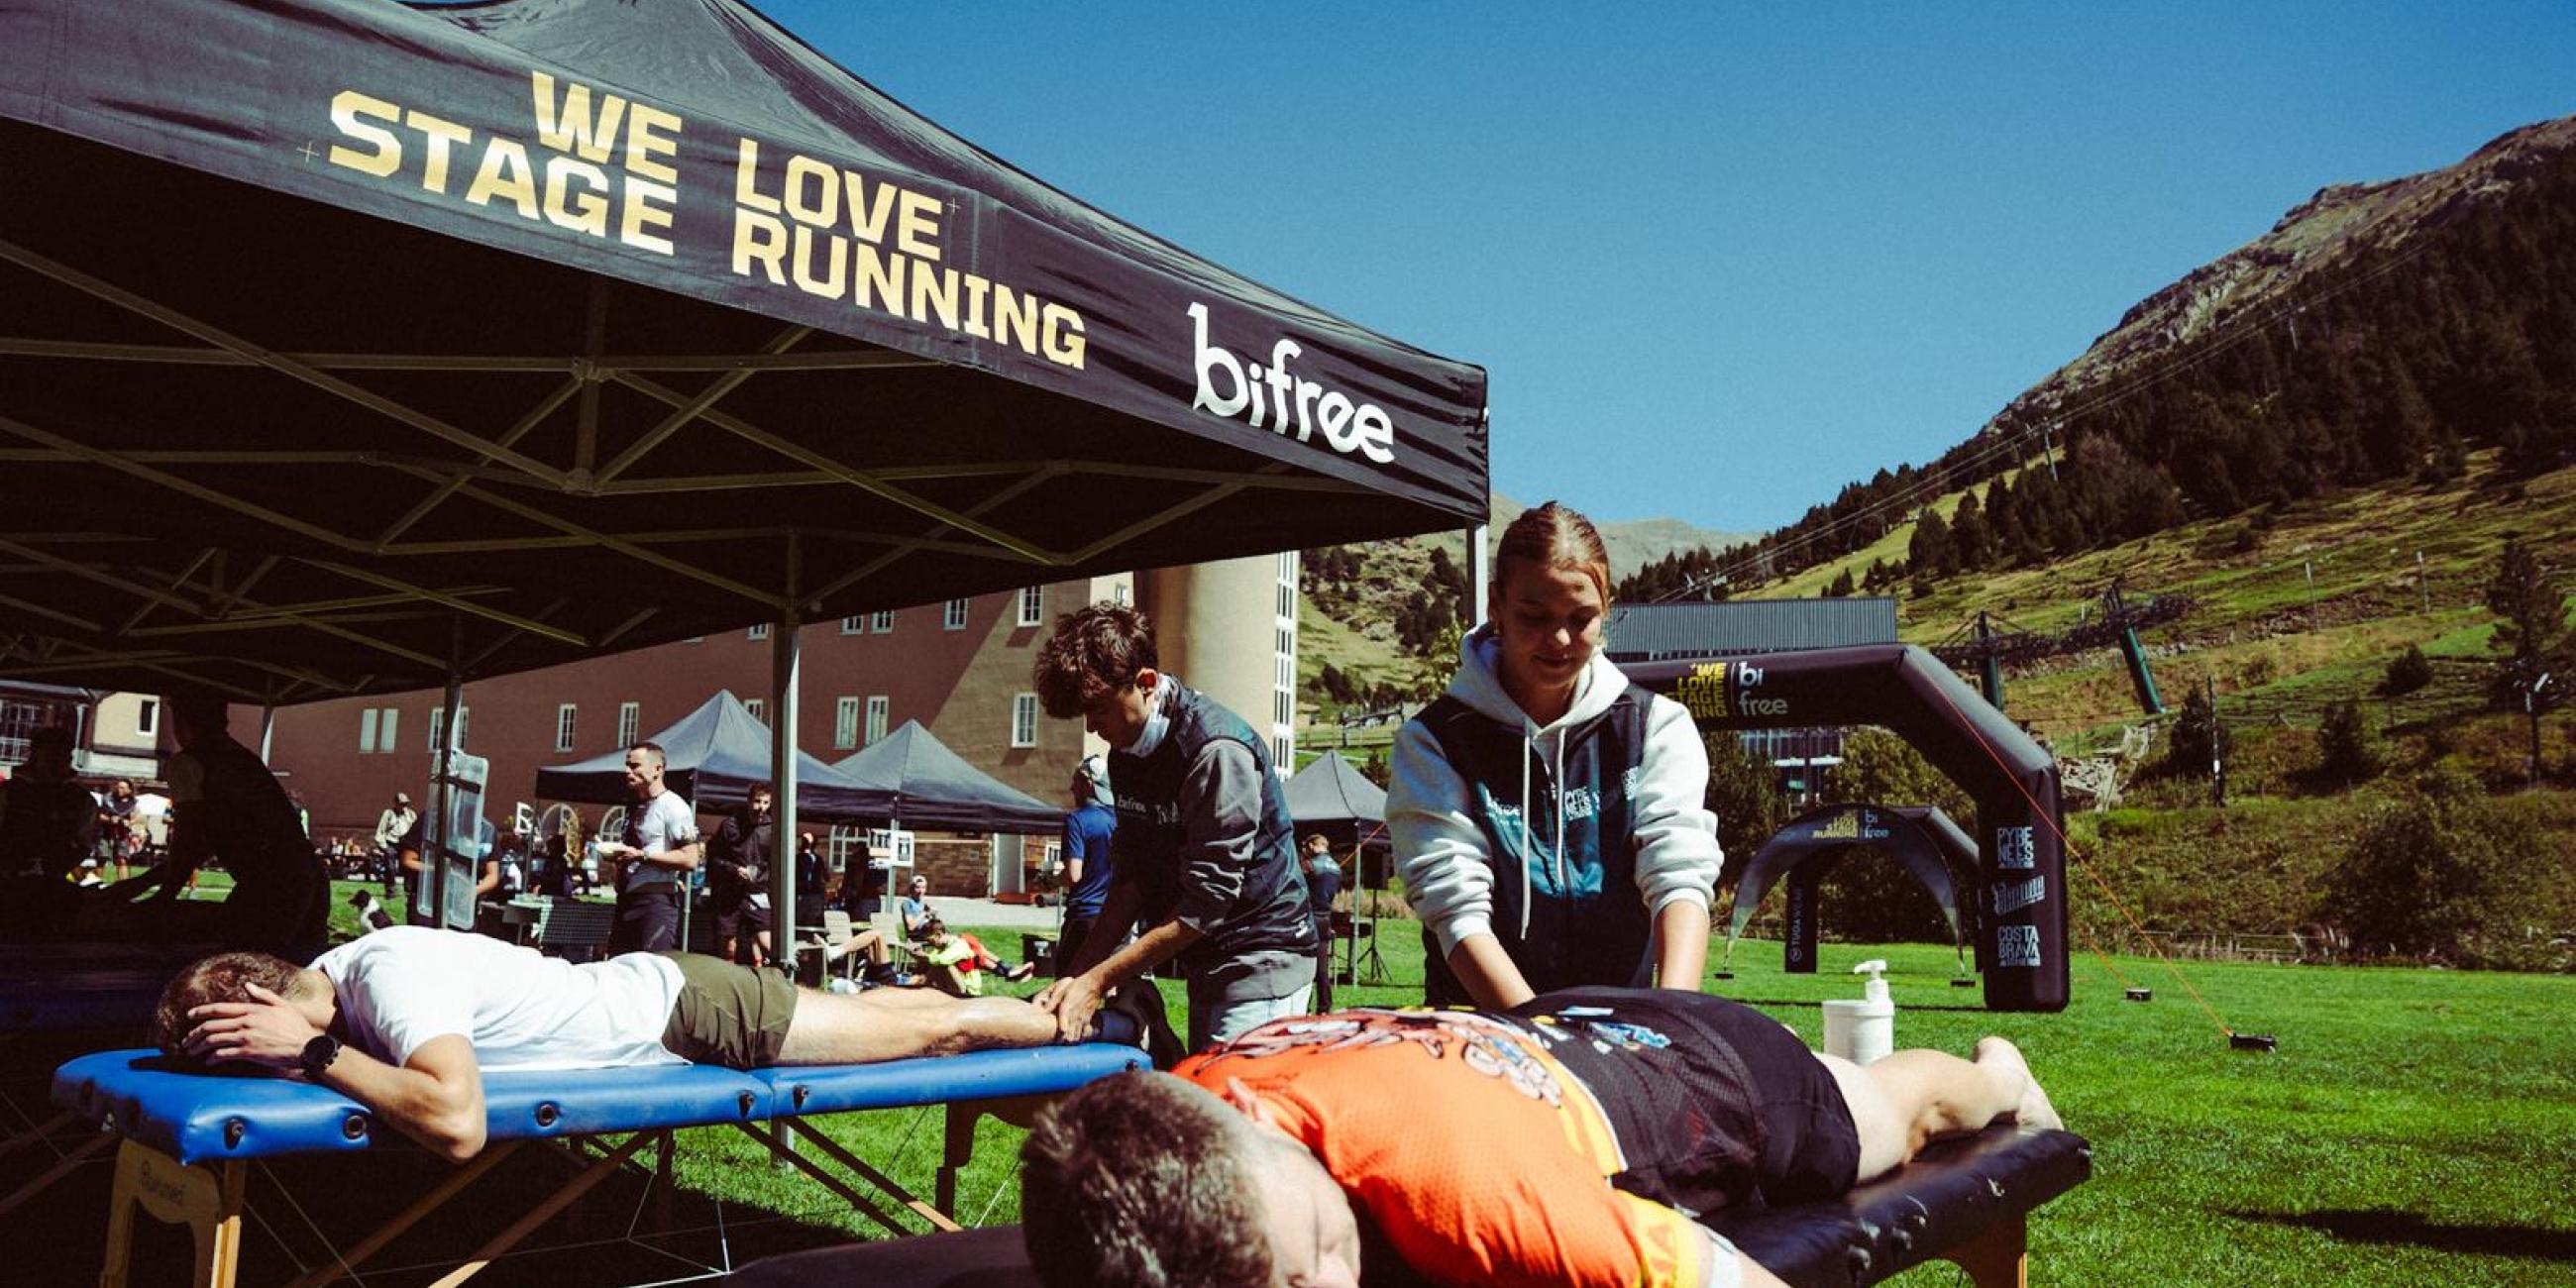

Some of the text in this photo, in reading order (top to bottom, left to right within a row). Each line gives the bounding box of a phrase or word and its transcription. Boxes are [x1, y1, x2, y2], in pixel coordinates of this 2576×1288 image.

[531, 70, 942, 261] WE LOVE
[329, 90, 1087, 371] STAGE RUNNING
[1187, 301, 1395, 464] bifree
[1696, 662, 1728, 678] WE
[1739, 661, 1764, 687] bi
[1677, 677, 1726, 692] LOVE
[1739, 691, 1789, 717] free
[1997, 924, 2040, 941] COSTA
[1998, 941, 2041, 959] BRAVA
